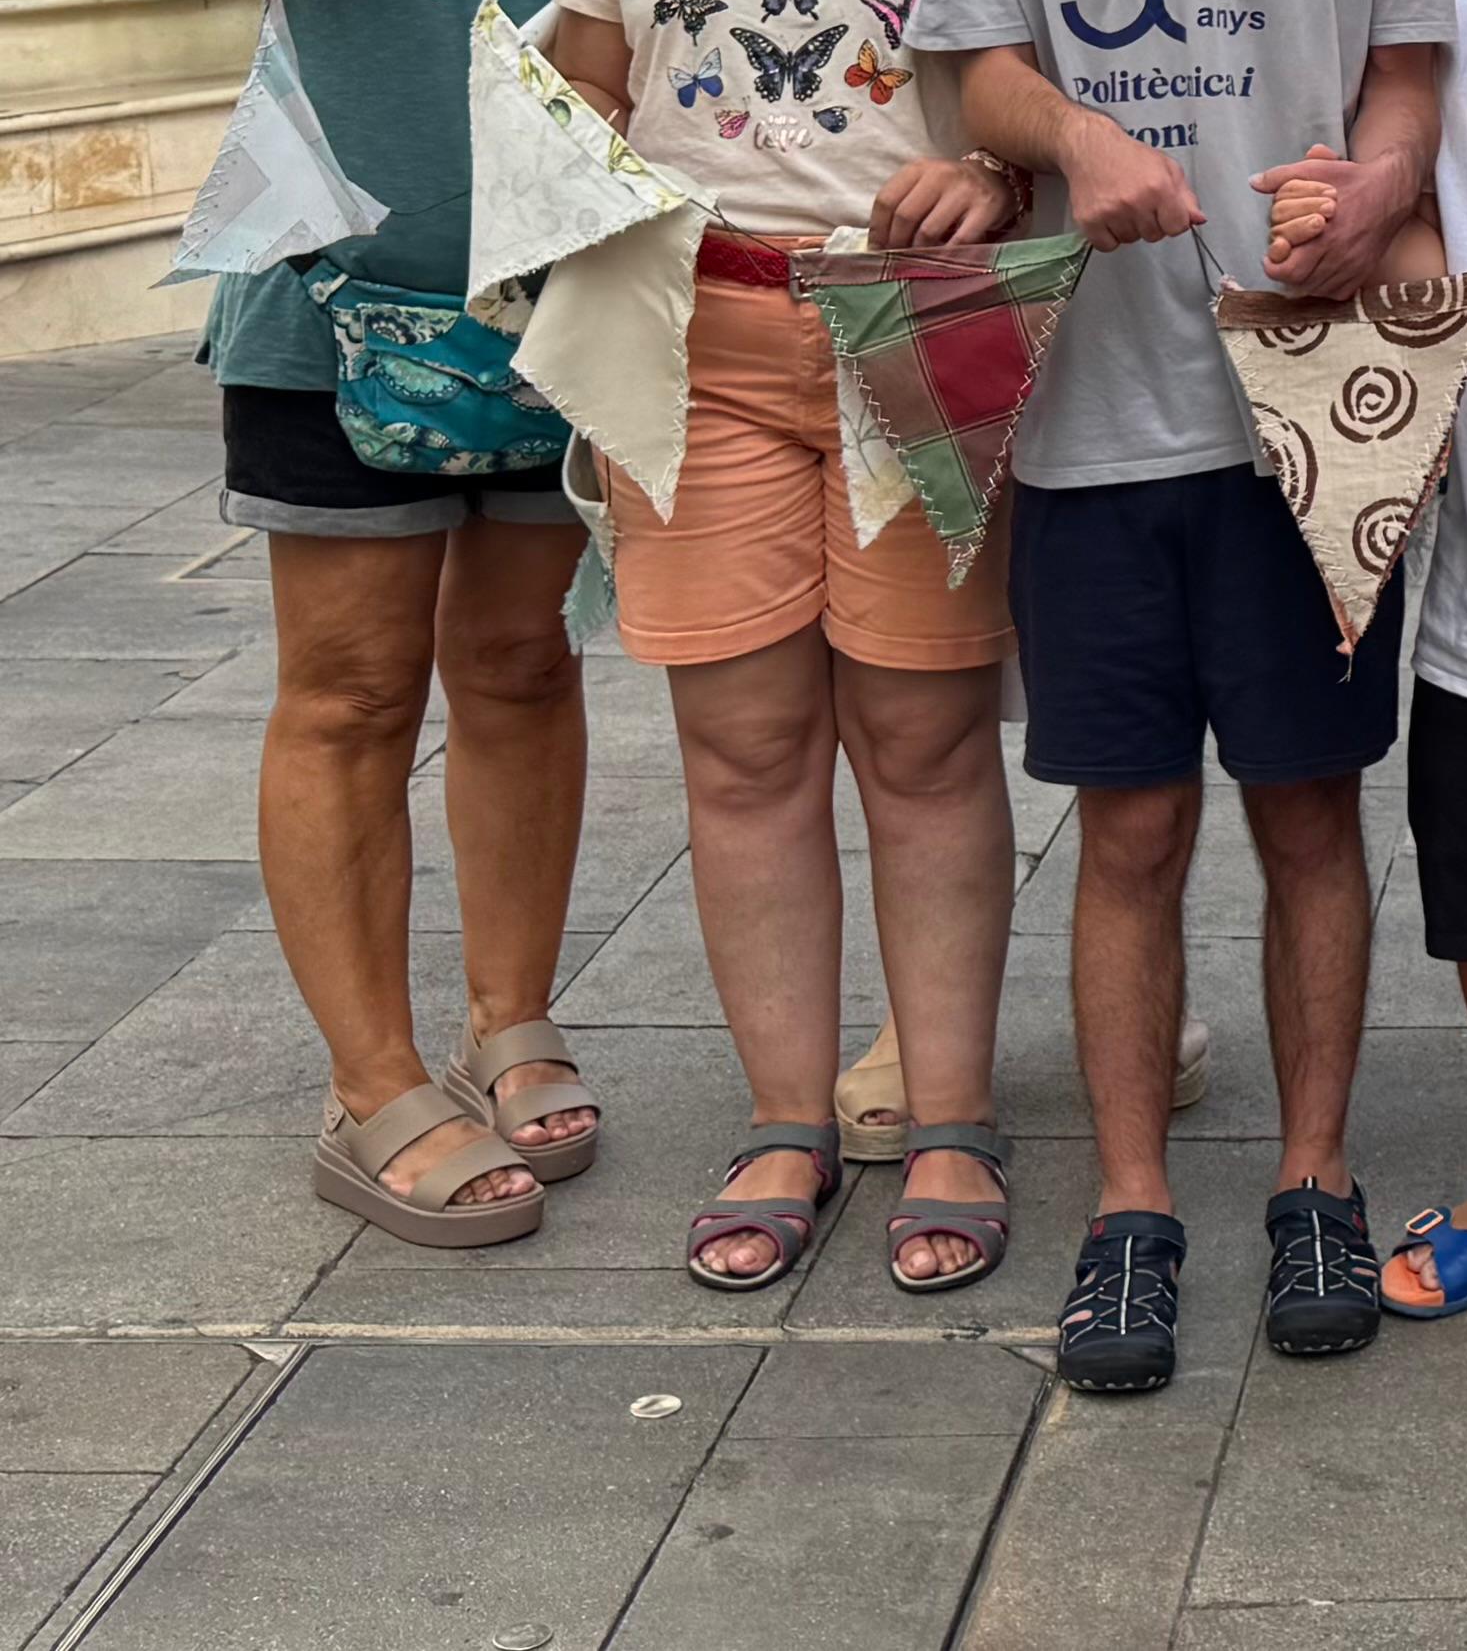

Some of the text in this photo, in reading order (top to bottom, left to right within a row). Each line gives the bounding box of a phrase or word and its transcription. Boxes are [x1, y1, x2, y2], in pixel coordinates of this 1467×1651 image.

[1197, 5, 1266, 35] anys
[1073, 66, 1255, 104] Politècnica i
